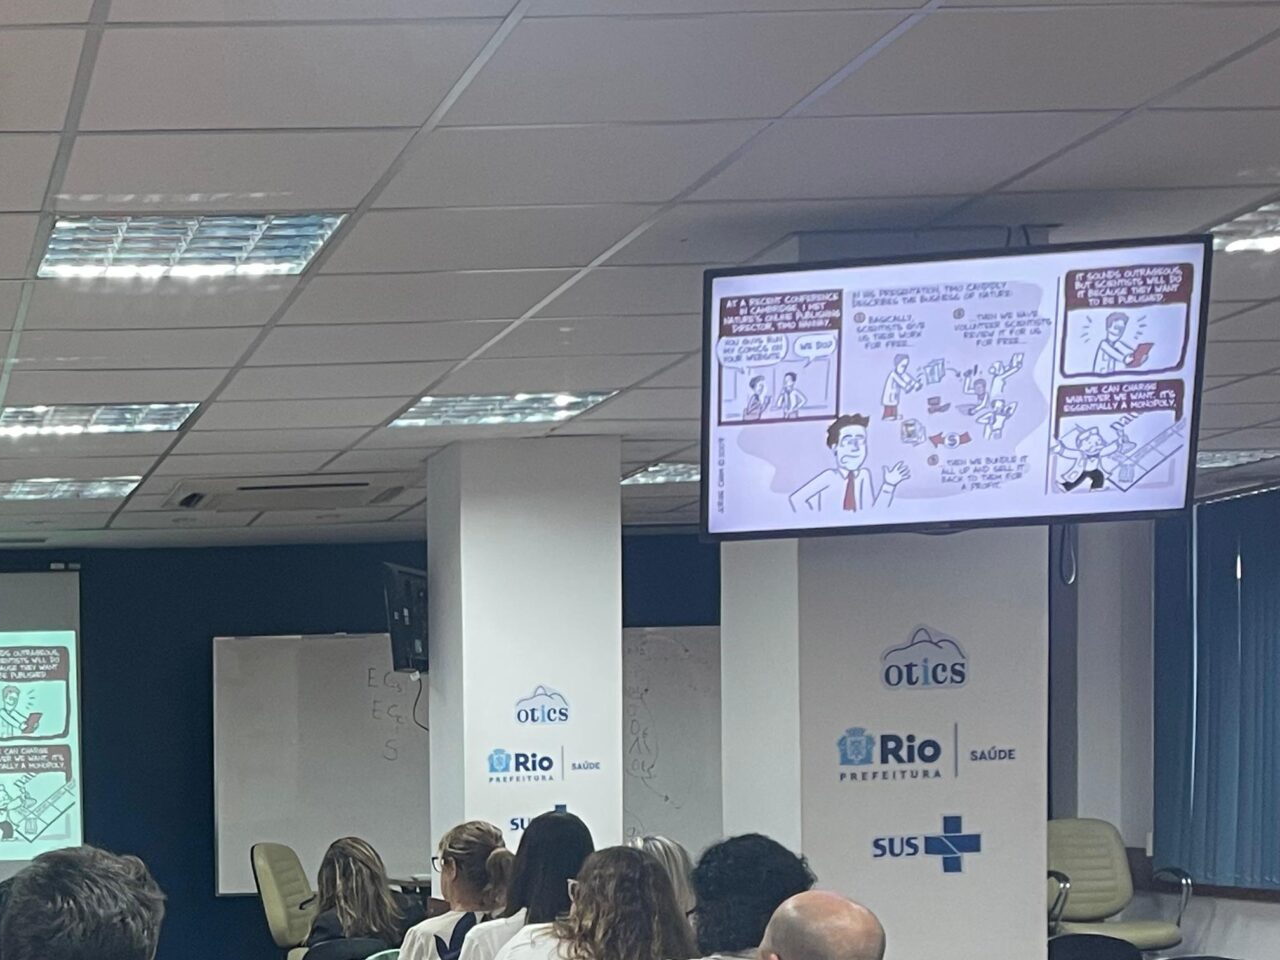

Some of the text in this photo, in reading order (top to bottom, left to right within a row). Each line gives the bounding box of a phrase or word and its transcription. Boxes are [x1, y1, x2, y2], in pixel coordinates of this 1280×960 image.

[884, 658, 966, 686] otics
[517, 704, 568, 723] otics
[880, 734, 1016, 764] Rio SAÚDE
[514, 753, 600, 772] Rio SAÚDE
[840, 770, 941, 781] PREFEITURA
[510, 818, 536, 831] SU
[873, 836, 919, 857] SUS
